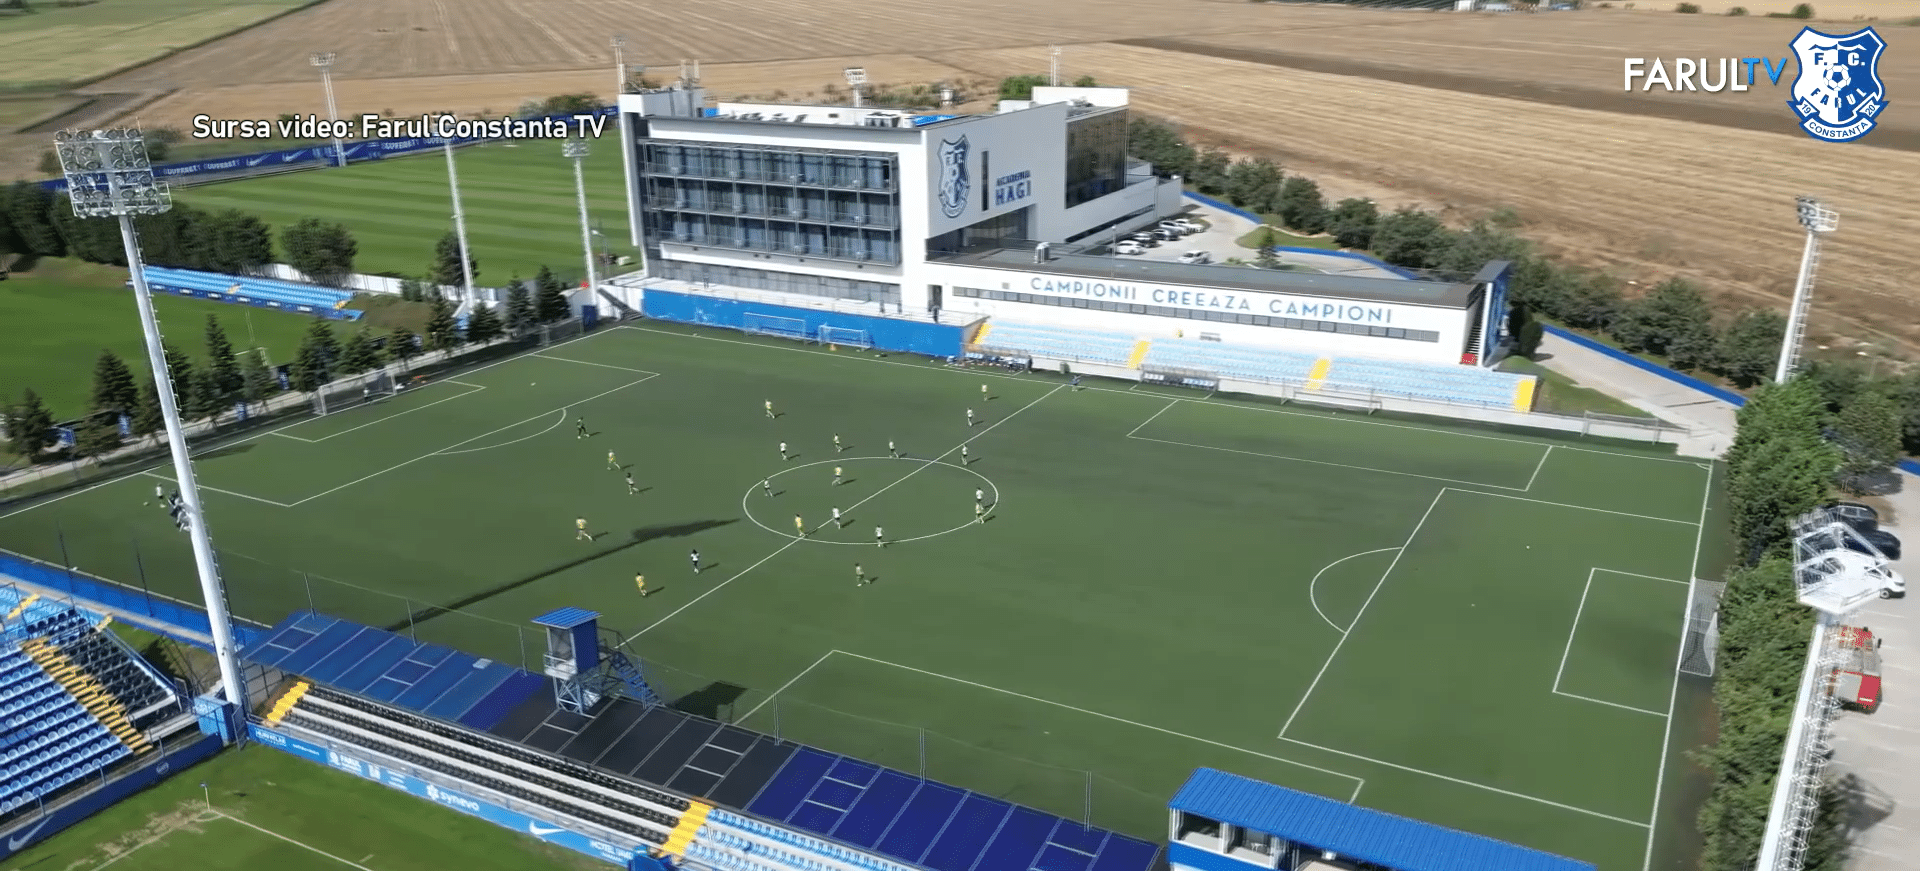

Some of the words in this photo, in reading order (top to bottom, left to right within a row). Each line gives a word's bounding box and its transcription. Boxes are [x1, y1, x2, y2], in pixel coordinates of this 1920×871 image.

[995, 180, 1032, 206] HAGI
[1030, 277, 1136, 300] CAMPIONII
[1152, 289, 1250, 311] CREEAZA
[1269, 299, 1392, 323] CAMPIONI
[440, 790, 480, 812] synevo
